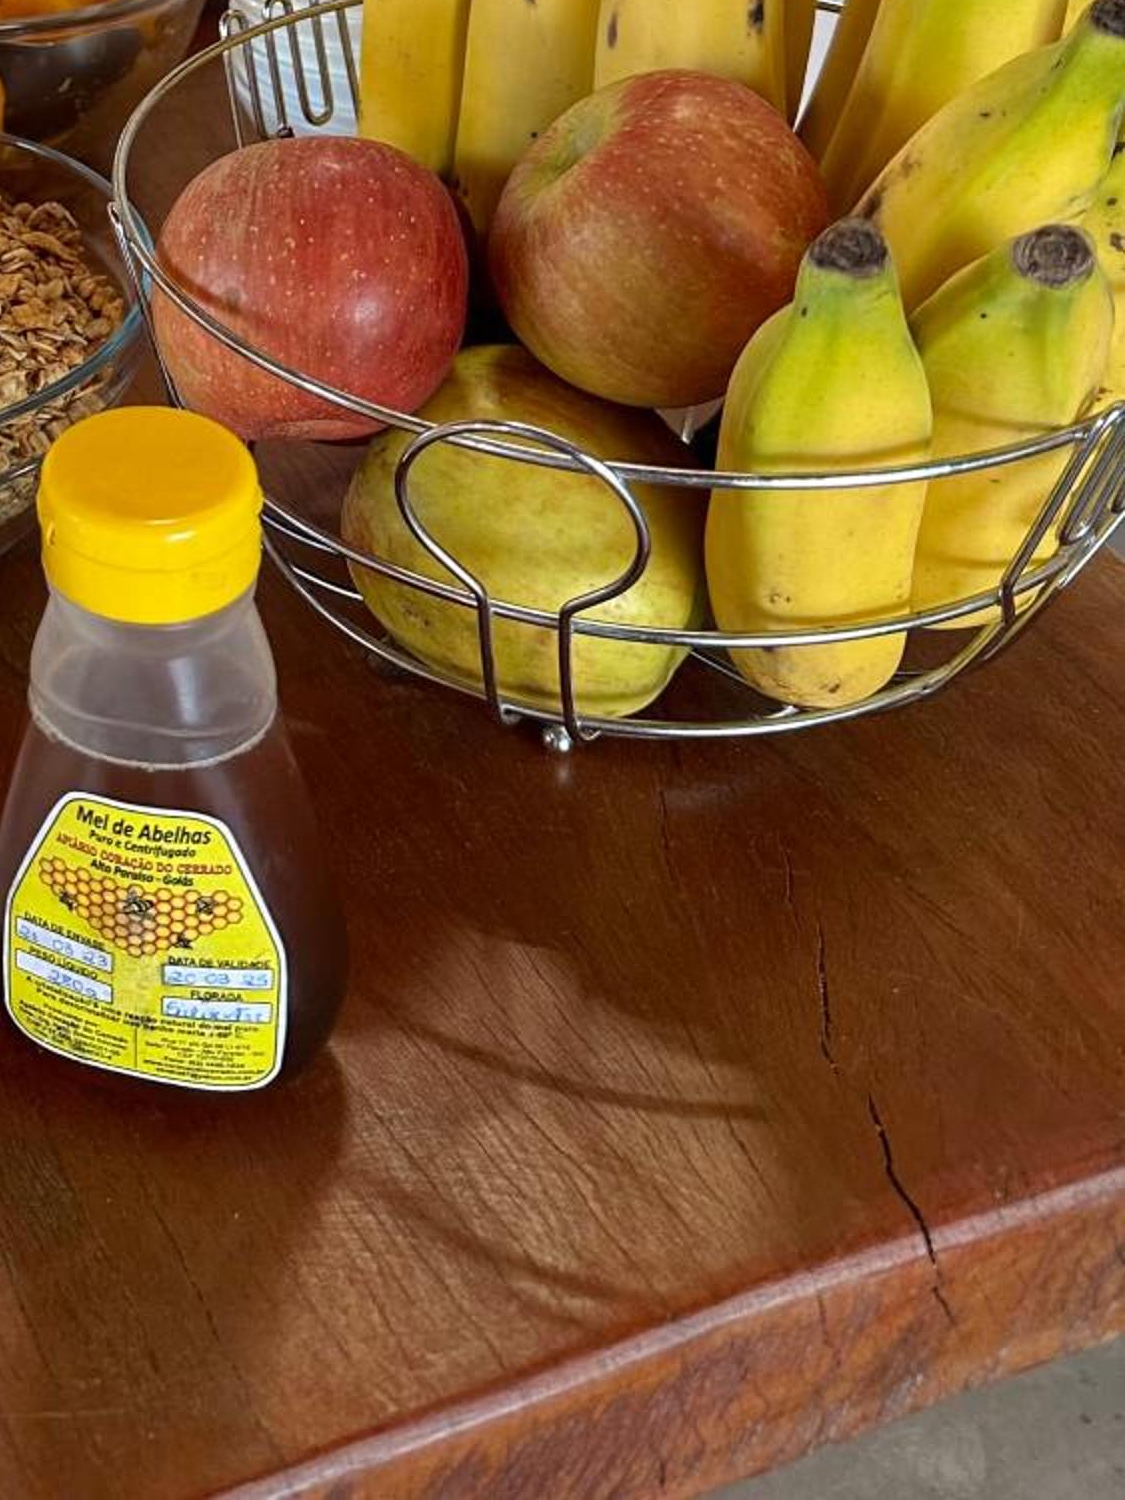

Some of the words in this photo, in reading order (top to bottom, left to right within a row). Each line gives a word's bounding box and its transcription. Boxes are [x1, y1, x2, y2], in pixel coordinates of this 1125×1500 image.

[76, 805, 109, 830] Mel
[112, 819, 134, 838] de
[138, 824, 212, 845] Abelhas
[89, 830, 114, 845] Puro
[124, 841, 197, 859] Centrifugado
[91, 859, 112, 874] Alto
[157, 862, 172, 873] DO
[168, 955, 196, 967] DATA
